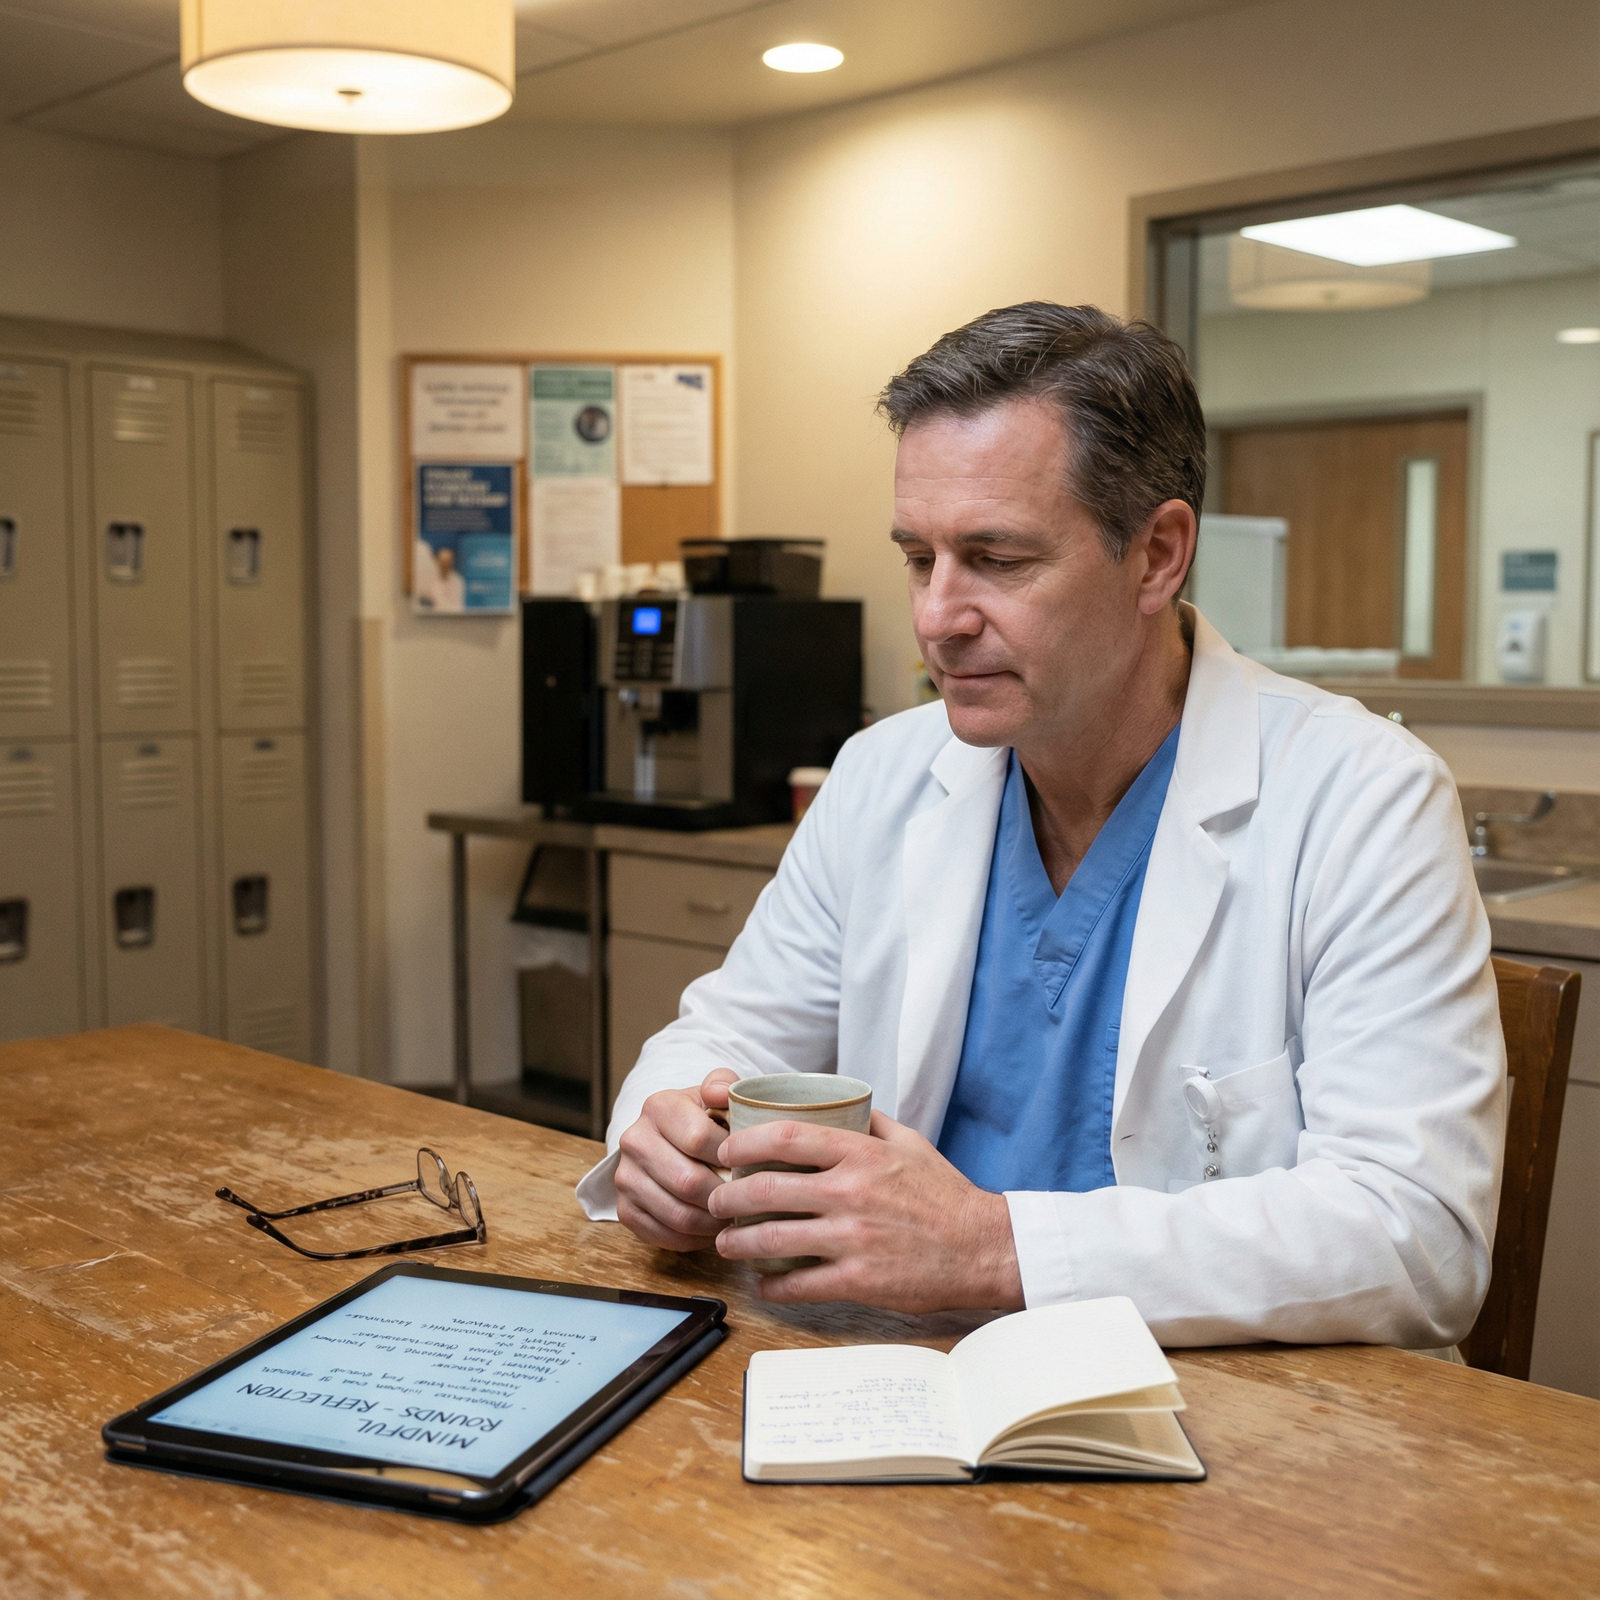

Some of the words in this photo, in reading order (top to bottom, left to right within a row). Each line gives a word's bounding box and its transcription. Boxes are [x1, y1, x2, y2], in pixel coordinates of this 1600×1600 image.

[237, 1383, 379, 1413] REFLECTION
[357, 1418, 479, 1449] MINDFUL
[399, 1406, 503, 1432] ROUNDS
